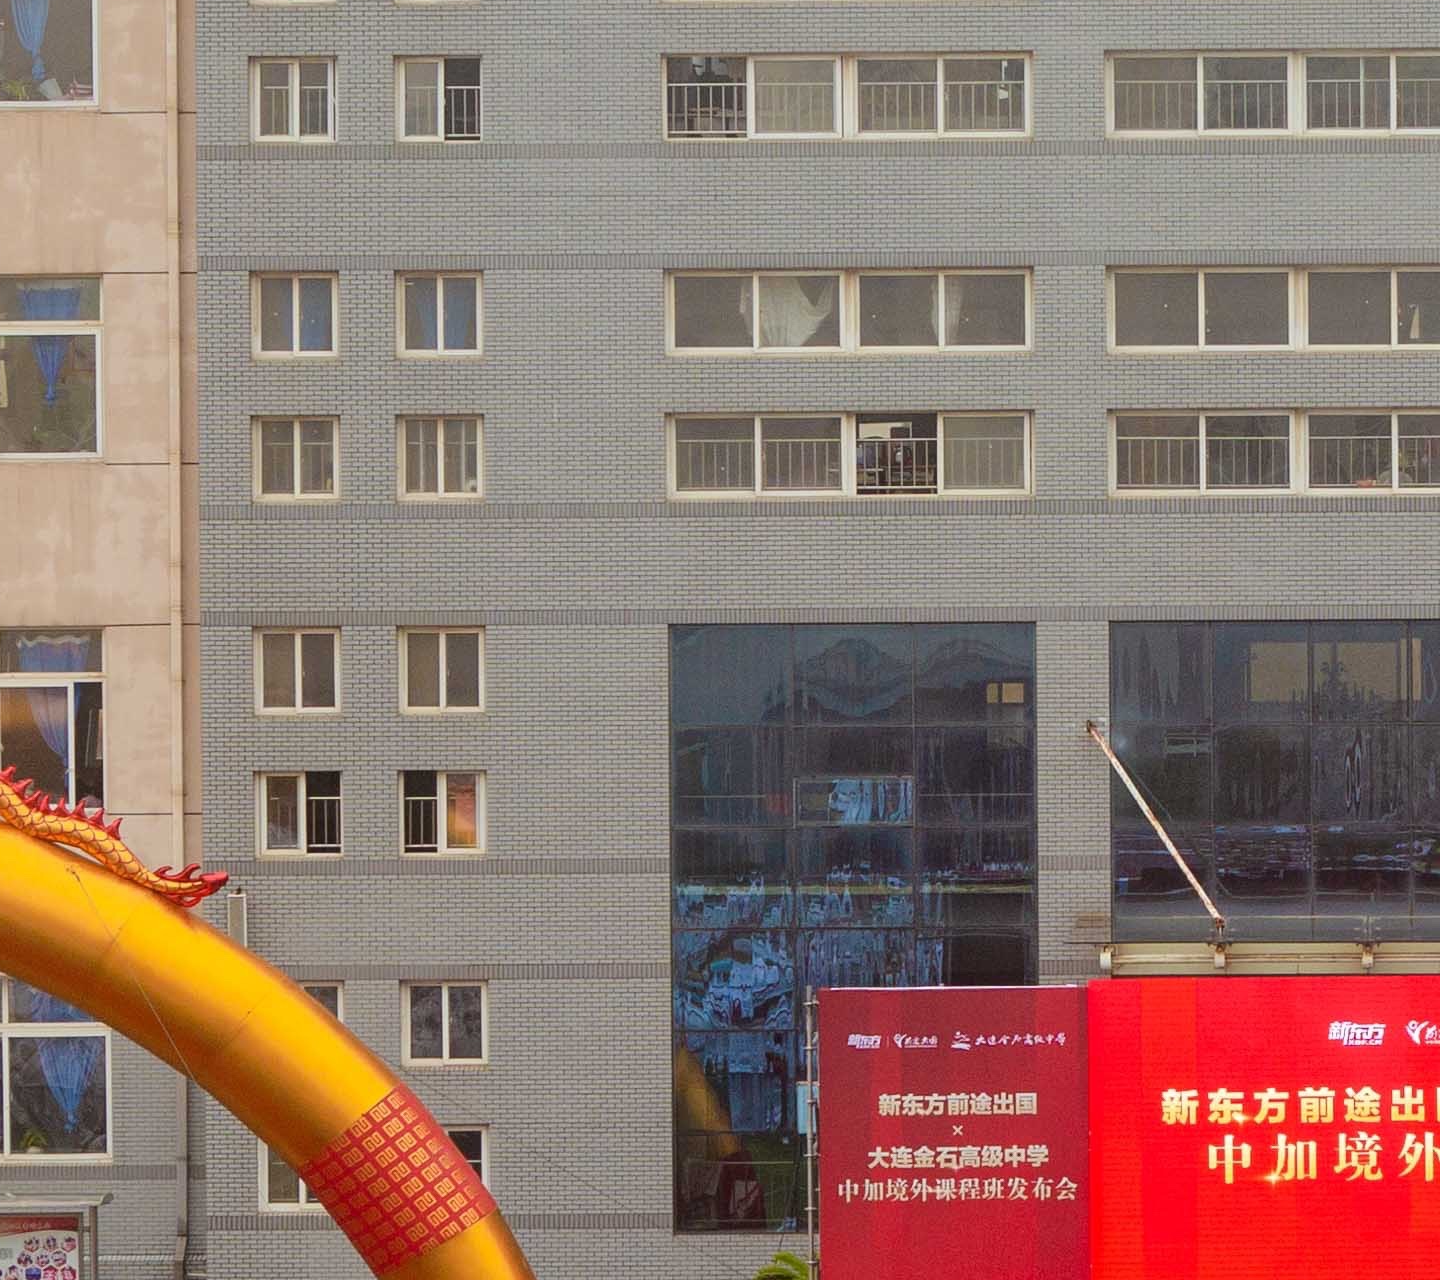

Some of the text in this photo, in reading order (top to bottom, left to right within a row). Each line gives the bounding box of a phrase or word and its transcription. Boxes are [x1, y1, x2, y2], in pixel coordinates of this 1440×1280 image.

[878, 1092, 1038, 1117] 新东方前途出国
[868, 1144, 1049, 1169] 大连金石高级中学
[837, 1176, 1078, 1202] 中加境外课程班发布会
